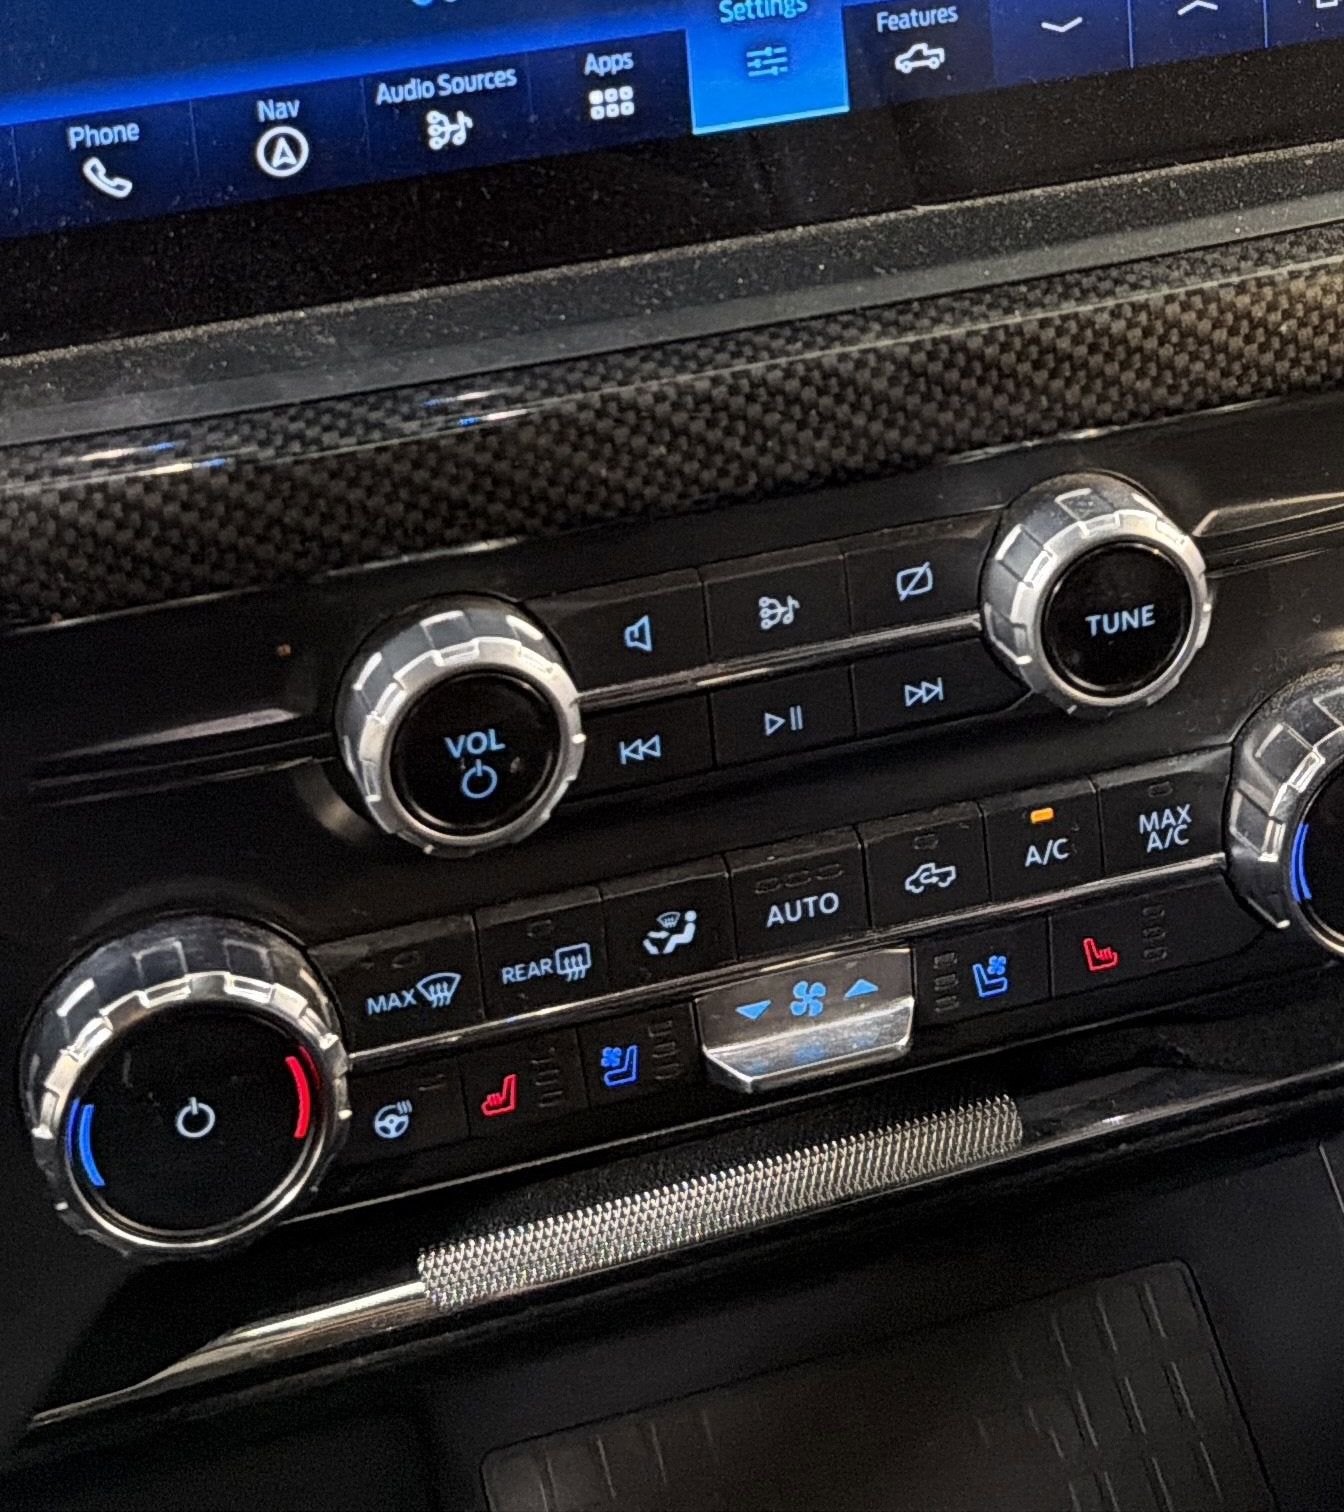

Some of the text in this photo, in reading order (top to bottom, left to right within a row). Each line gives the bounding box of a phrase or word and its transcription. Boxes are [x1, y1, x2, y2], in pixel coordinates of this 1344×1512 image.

[876, 5, 959, 33] Features
[583, 52, 635, 77] Apps
[375, 68, 518, 106] Audio Sources
[256, 98, 301, 123] Nav
[67, 122, 140, 150] Phone
[1084, 603, 1156, 637] TUNE
[444, 728, 506, 759] VOL
[1138, 803, 1193, 834] MAX
[1024, 837, 1070, 867] A/C
[1146, 825, 1190, 854] A/C
[766, 892, 840, 928] AUTO
[501, 954, 554, 986] REAR
[365, 986, 417, 1016] MAX
